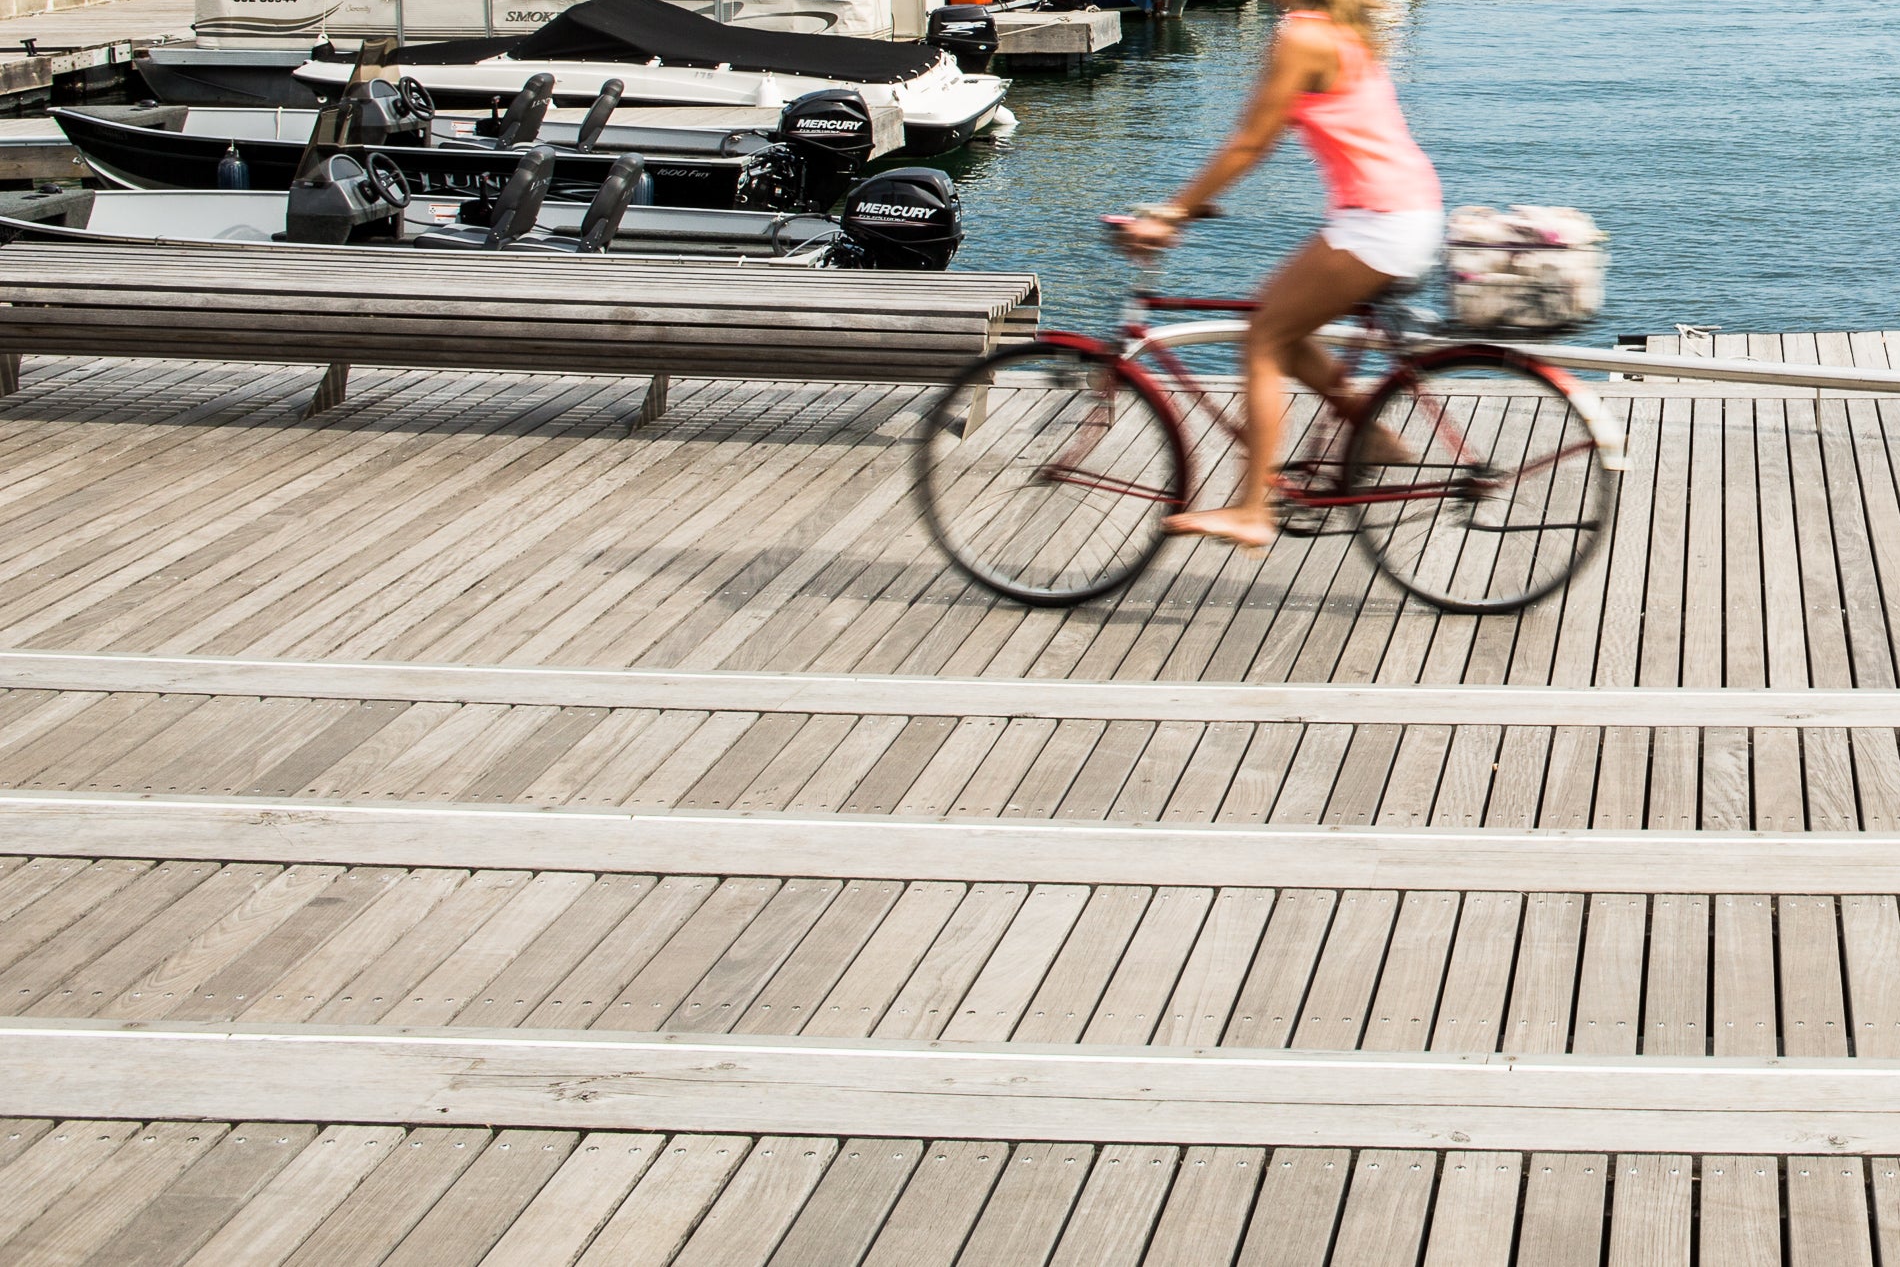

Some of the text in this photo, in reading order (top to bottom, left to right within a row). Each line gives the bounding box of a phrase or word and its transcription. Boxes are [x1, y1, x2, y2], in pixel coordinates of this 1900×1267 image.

[505, 10, 560, 23] SMOK
[796, 118, 863, 131] MERCURY
[856, 201, 937, 220] MERCURY
